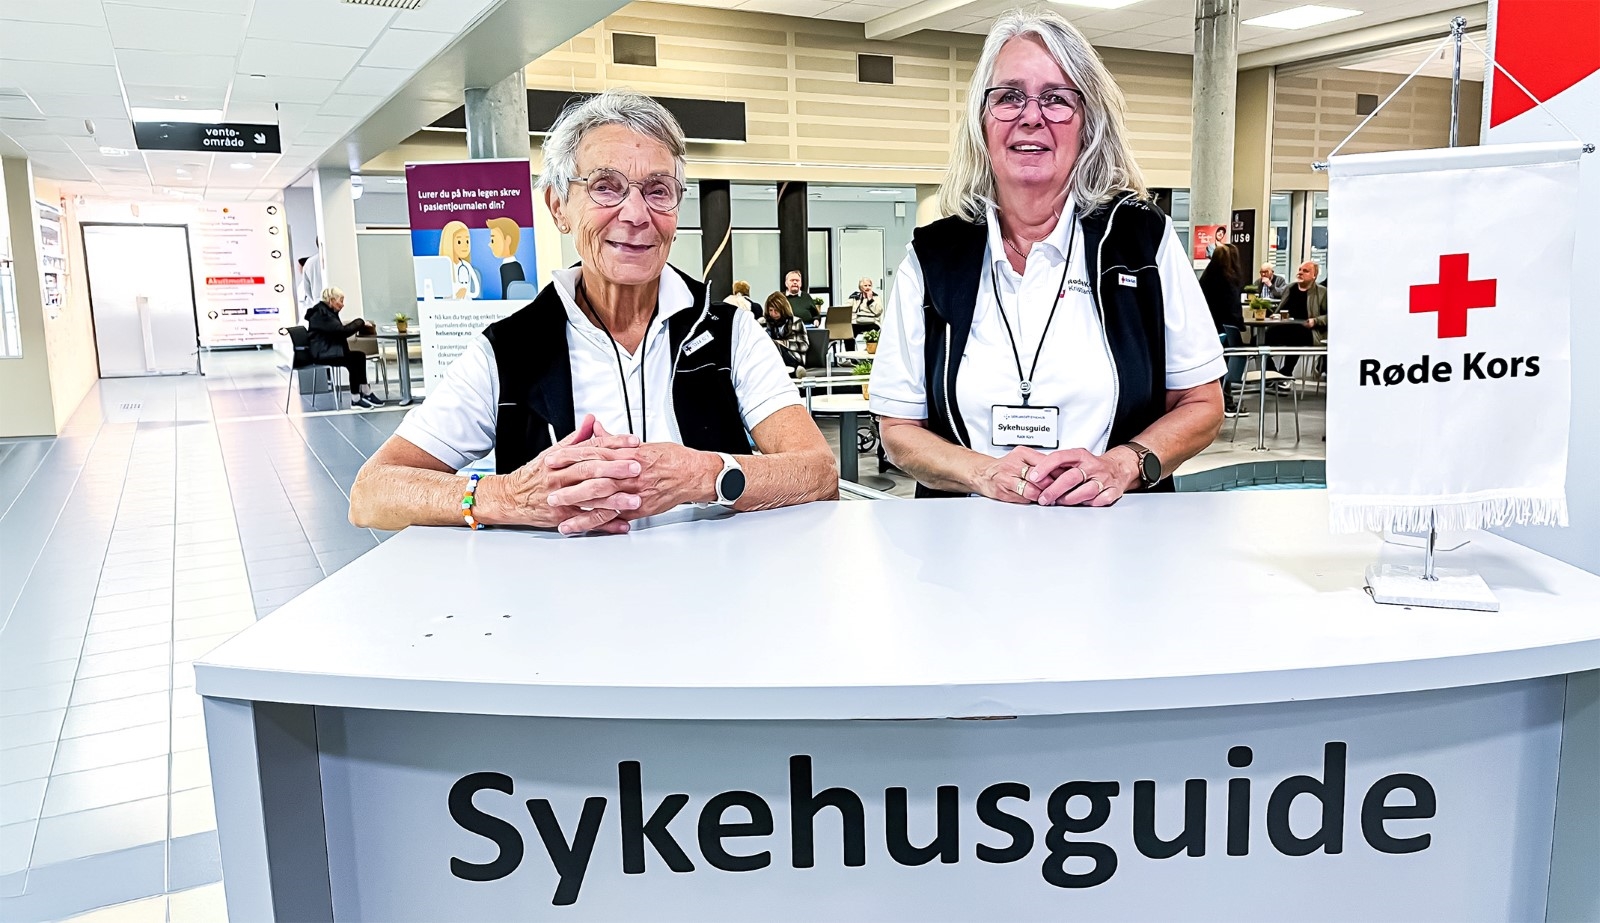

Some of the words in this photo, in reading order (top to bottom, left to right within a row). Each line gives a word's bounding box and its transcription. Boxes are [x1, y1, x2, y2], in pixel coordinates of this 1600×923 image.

[205, 128, 240, 137] vente-
[203, 137, 245, 147] område
[418, 190, 438, 199] Lurer
[440, 189, 450, 199] du
[451, 188, 461, 199] på
[462, 188, 476, 198] hva
[478, 188, 499, 199] legen
[500, 187, 520, 197] skrev
[423, 201, 487, 213] pasientjournalen
[489, 200, 505, 210] din?
[1359, 354, 1452, 387] Røde
[1463, 351, 1540, 381] Kors
[997, 423, 1051, 433] Sykehusguide
[447, 741, 1438, 907] Sykehusguide
